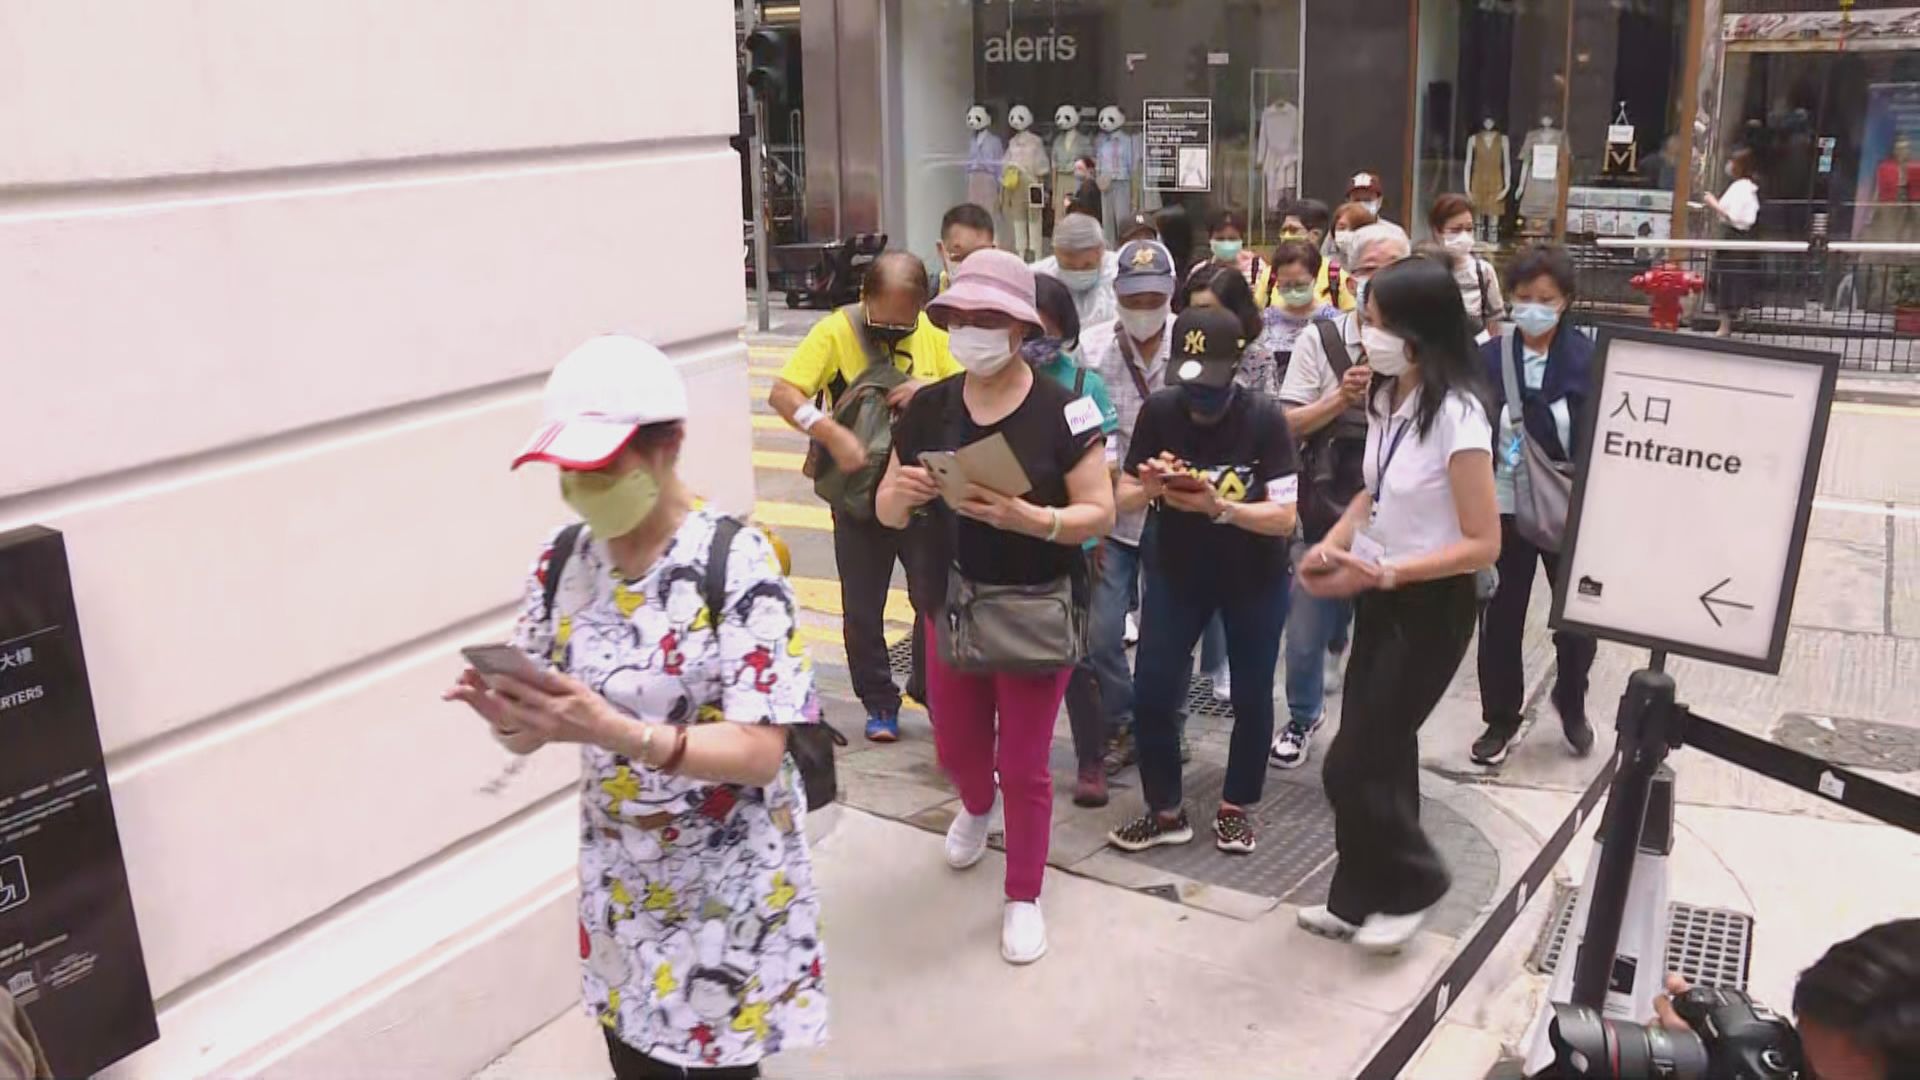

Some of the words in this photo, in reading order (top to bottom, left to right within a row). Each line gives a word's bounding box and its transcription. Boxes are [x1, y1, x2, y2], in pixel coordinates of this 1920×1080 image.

[984, 27, 1077, 63] aleris
[1184, 330, 1205, 354] NY
[1609, 391, 1671, 425] 入口
[1604, 431, 1742, 474] Entrance
